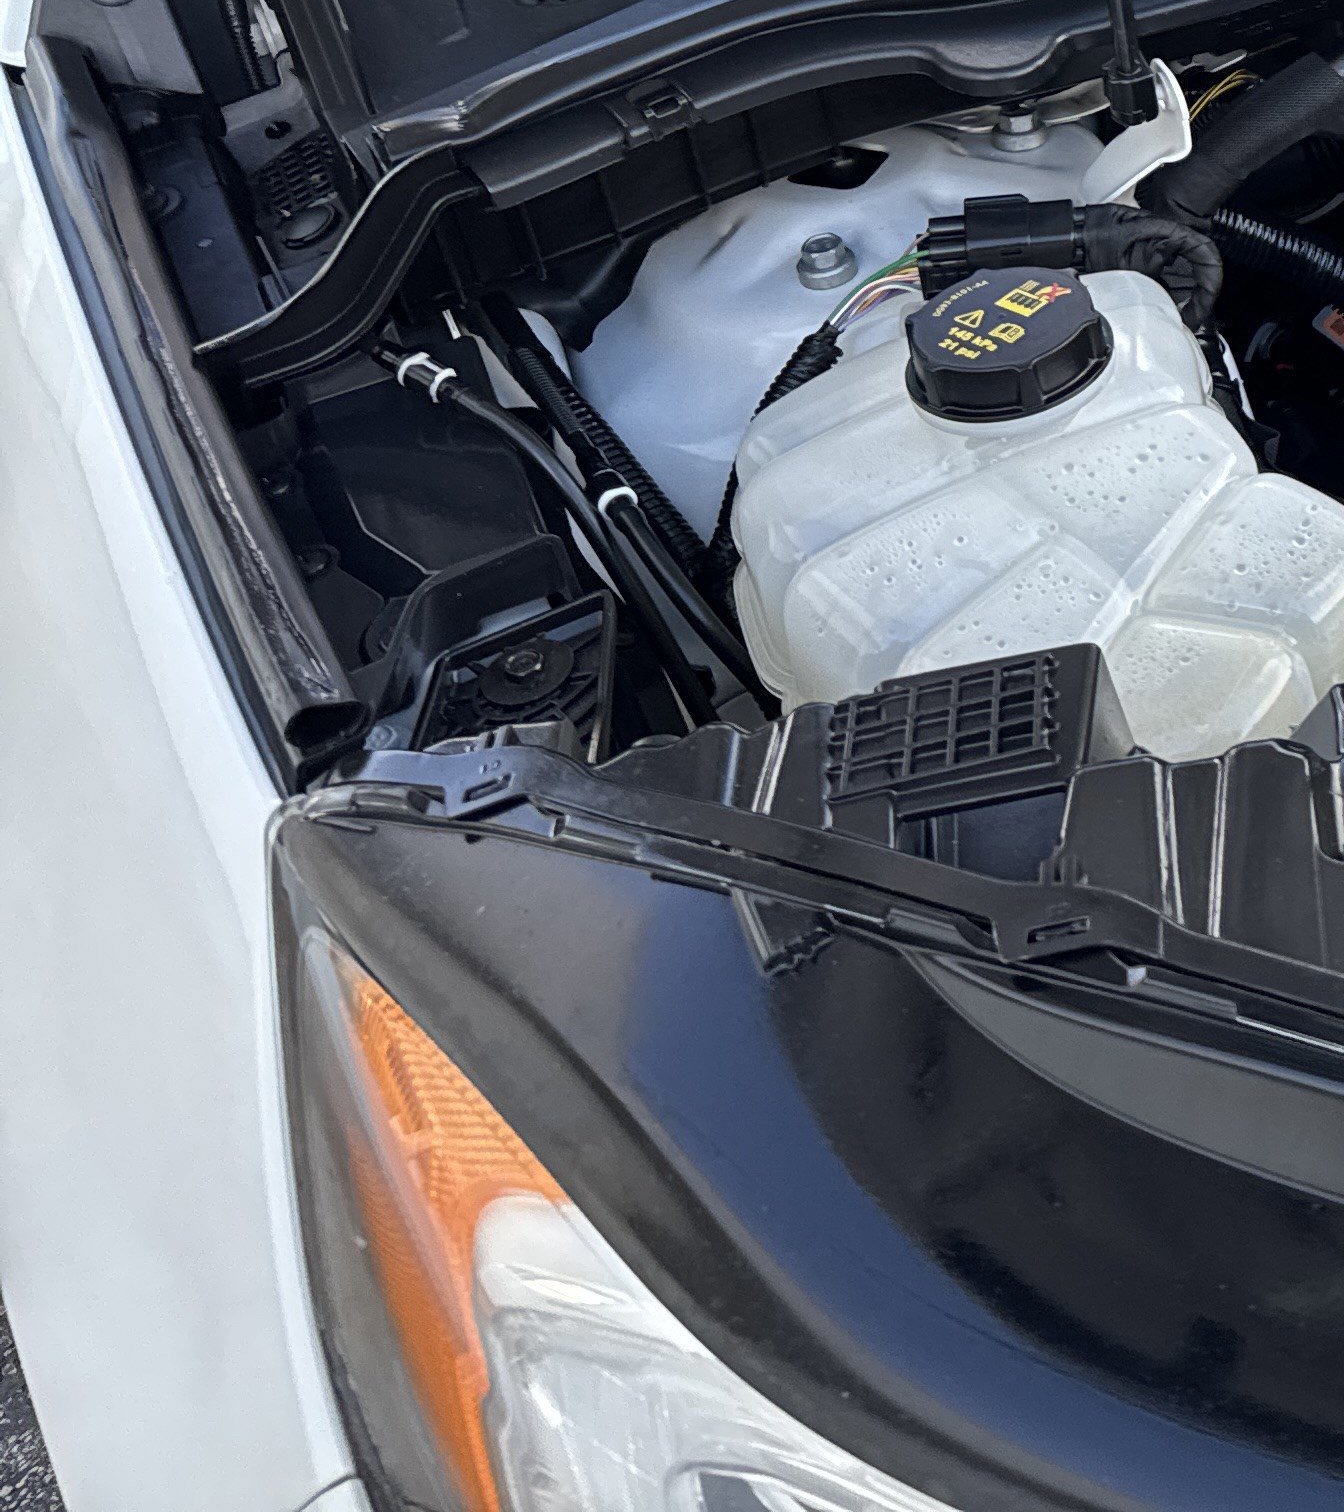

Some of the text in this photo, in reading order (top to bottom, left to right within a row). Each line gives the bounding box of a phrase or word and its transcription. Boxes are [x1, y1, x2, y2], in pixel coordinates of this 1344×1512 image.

[948, 327, 974, 341] 145
[938, 338, 981, 360] 21 psi
